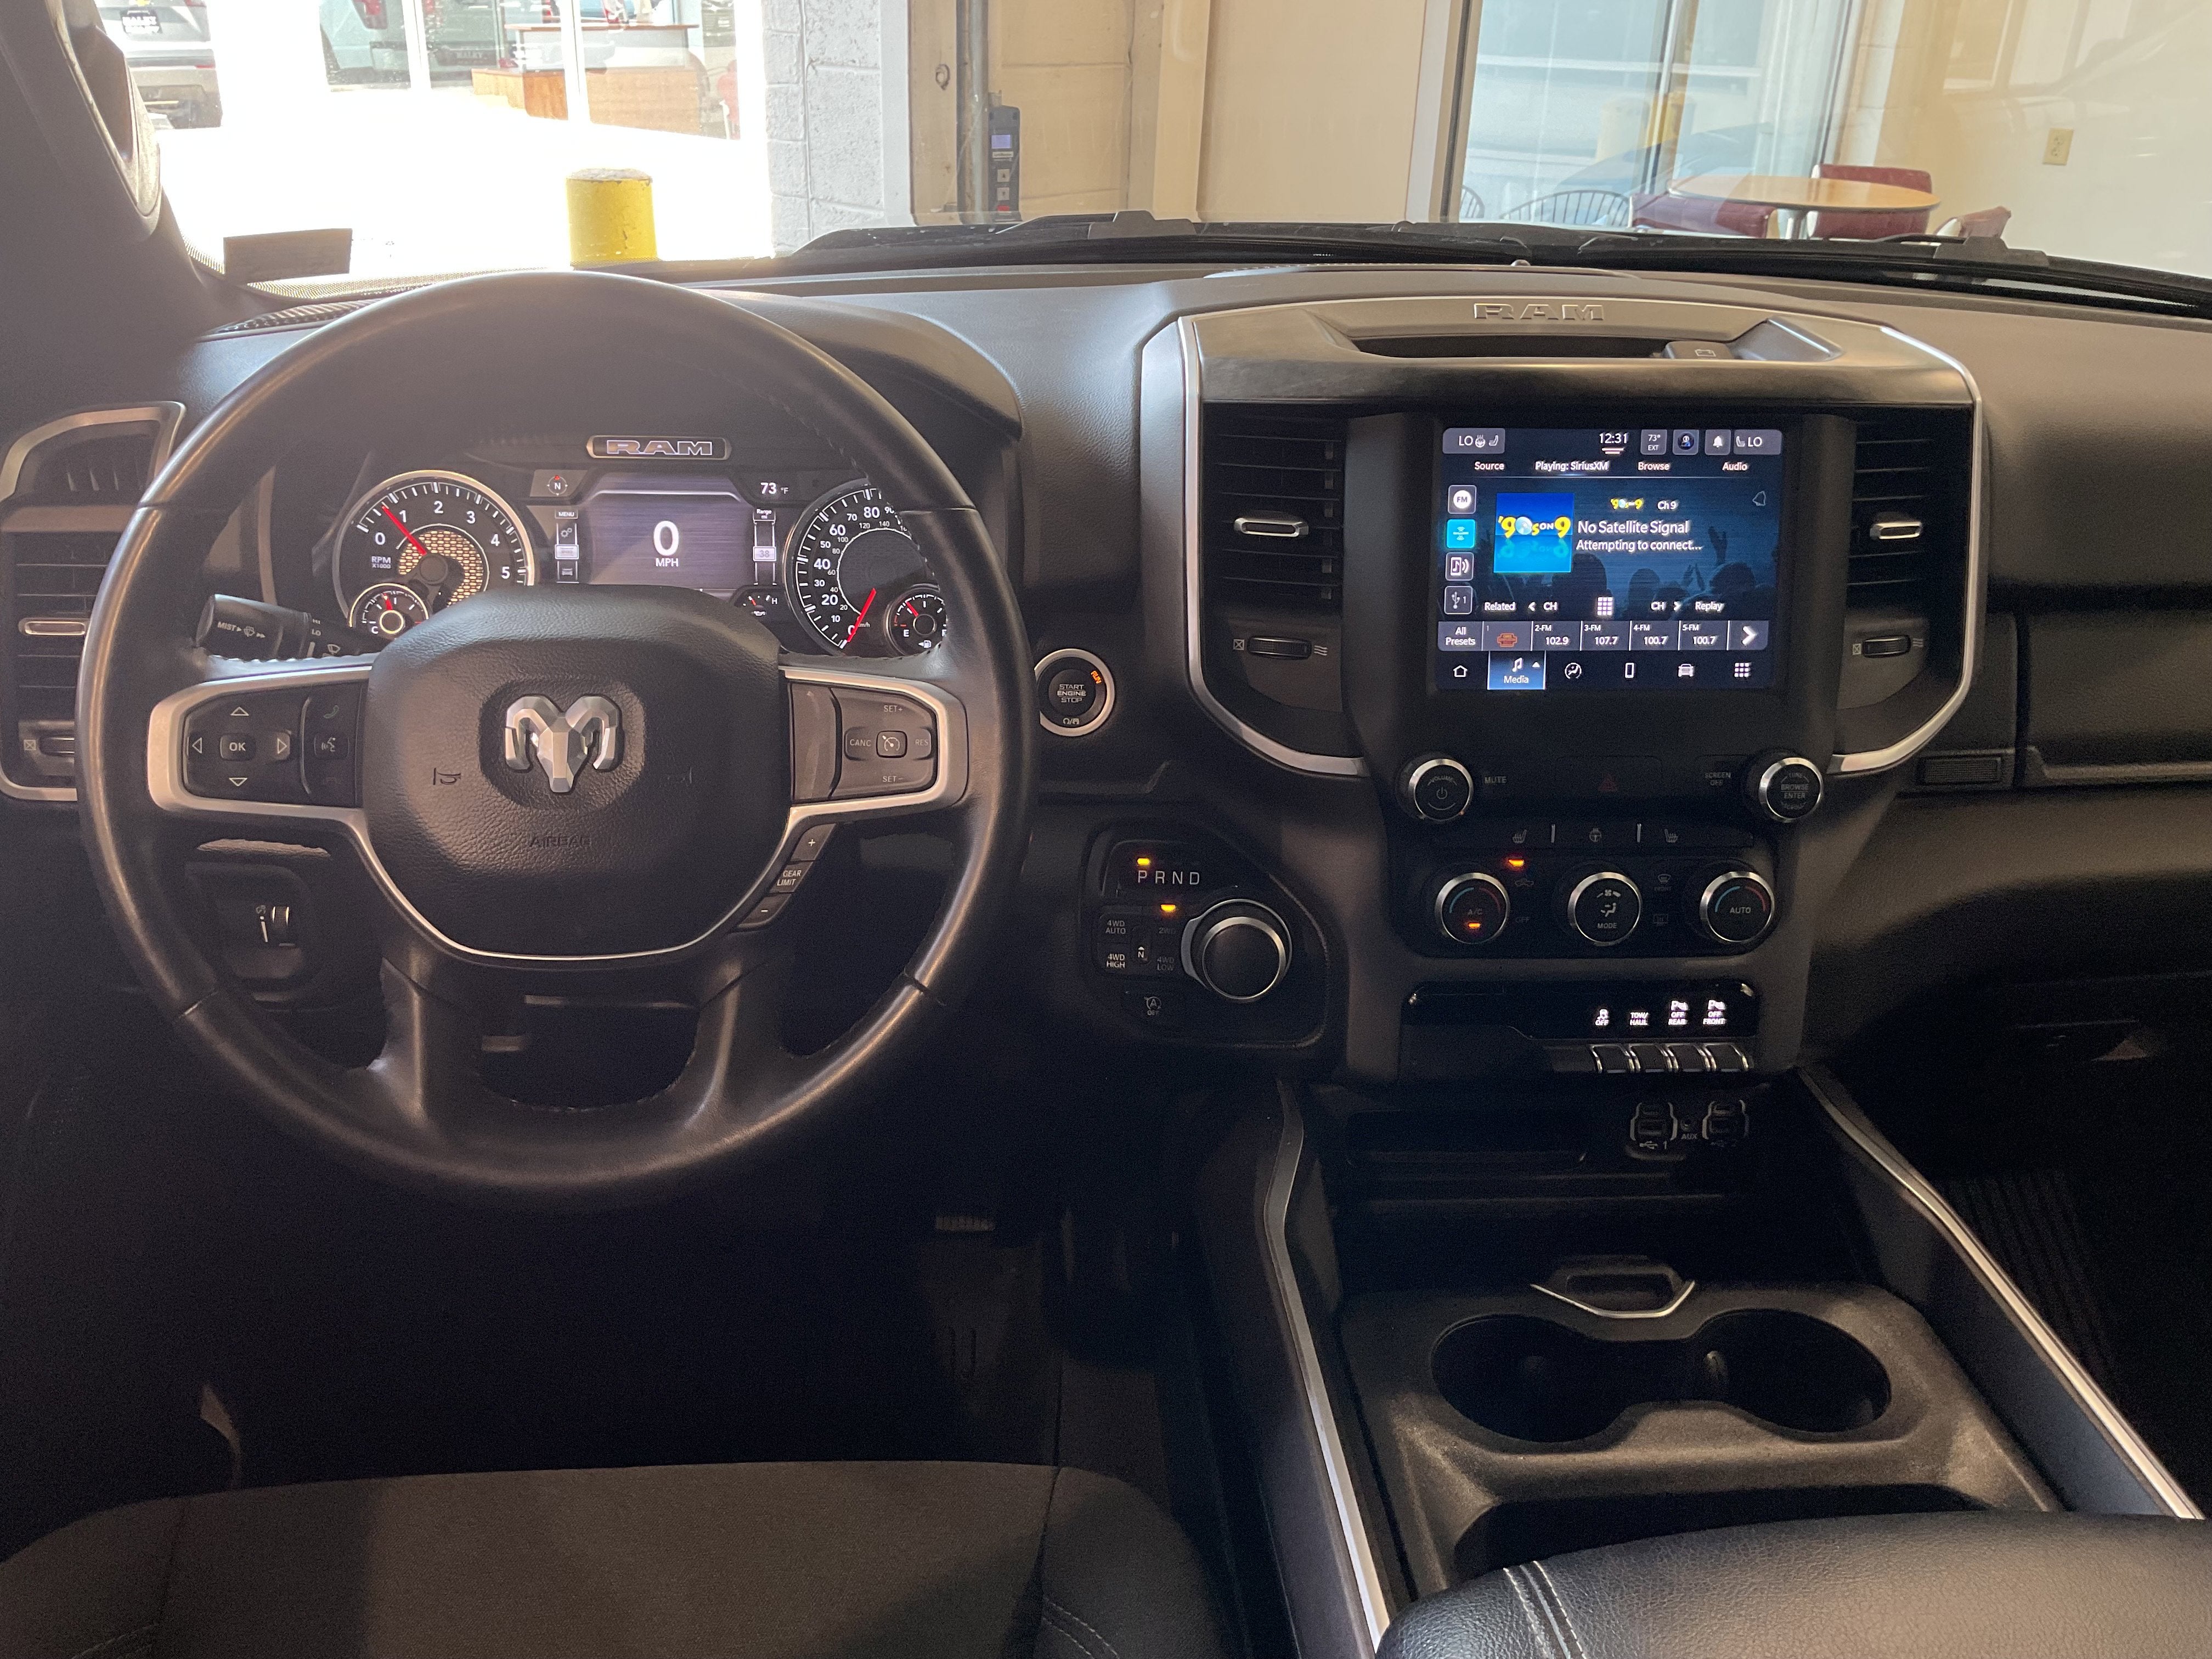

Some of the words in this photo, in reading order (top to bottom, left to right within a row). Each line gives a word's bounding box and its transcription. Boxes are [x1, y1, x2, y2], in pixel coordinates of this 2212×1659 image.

[1474, 302, 1605, 320] RAM
[1459, 435, 1473, 446] LO
[1599, 433, 1628, 444] 12:31
[1747, 436, 1763, 447] LO
[606, 439, 713, 456] RAM
[1474, 461, 1505, 471] Source
[1534, 461, 1569, 472] Playing:
[1570, 461, 1610, 471] SiriusXM
[1638, 461, 1670, 471] Browse
[1722, 462, 1748, 471] Audio
[554, 482, 561, 490] N
[760, 482, 777, 494] 73
[435, 501, 443, 514] 2
[1657, 500, 1669, 510] Ch
[1670, 500, 1677, 510] 9
[400, 510, 407, 522] 1
[466, 511, 476, 523] 3
[756, 508, 772, 516] Range
[864, 506, 880, 519] 80
[847, 513, 857, 522] 70
[829, 524, 846, 536] 60
[1539, 522, 1554, 531] ON
[1554, 516, 1571, 538] 9
[1578, 521, 1596, 533] No
[1598, 521, 1648, 534] Satellite
[1650, 521, 1690, 535] Signal
[375, 532, 386, 545] 0
[490, 534, 500, 546] 4
[653, 520, 680, 556] 0
[820, 540, 831, 549] 50
[1576, 539, 1635, 552] Attempting
[1637, 540, 1649, 551] to
[759, 550, 770, 558] 38
[371, 556, 392, 565] RPM
[656, 557, 679, 568] MPH
[814, 558, 831, 570] 40
[501, 567, 510, 579] 5
[814, 579, 825, 587] 30
[821, 594, 838, 606] 20
[1483, 601, 1516, 611] Related
[1543, 601, 1558, 611] CH
[1650, 601, 1667, 611] CH
[1695, 601, 1724, 612] Replay
[831, 614, 840, 623] 10
[217, 621, 236, 633] MIST
[371, 625, 379, 634] C
[1455, 627, 1467, 635] All
[1683, 623, 1699, 631] 5-FM
[312, 629, 321, 637] LO
[903, 629, 910, 637] E
[1444, 636, 1476, 646] Presets
[1545, 636, 1570, 646] 102.9
[1595, 636, 1618, 646] 107.7
[1644, 635, 1668, 645] 100.7
[1692, 635, 1717, 645] 100.7
[1091, 670, 1102, 684] RUN
[1503, 675, 1530, 684] Media
[229, 742, 246, 752] OK
[850, 738, 871, 747] CANC
[1430, 775, 1454, 783] VOLUME
[1137, 870, 1147, 884] P
[1155, 871, 1165, 884] R
[1172, 871, 1183, 885] N
[1189, 872, 1200, 885] D
